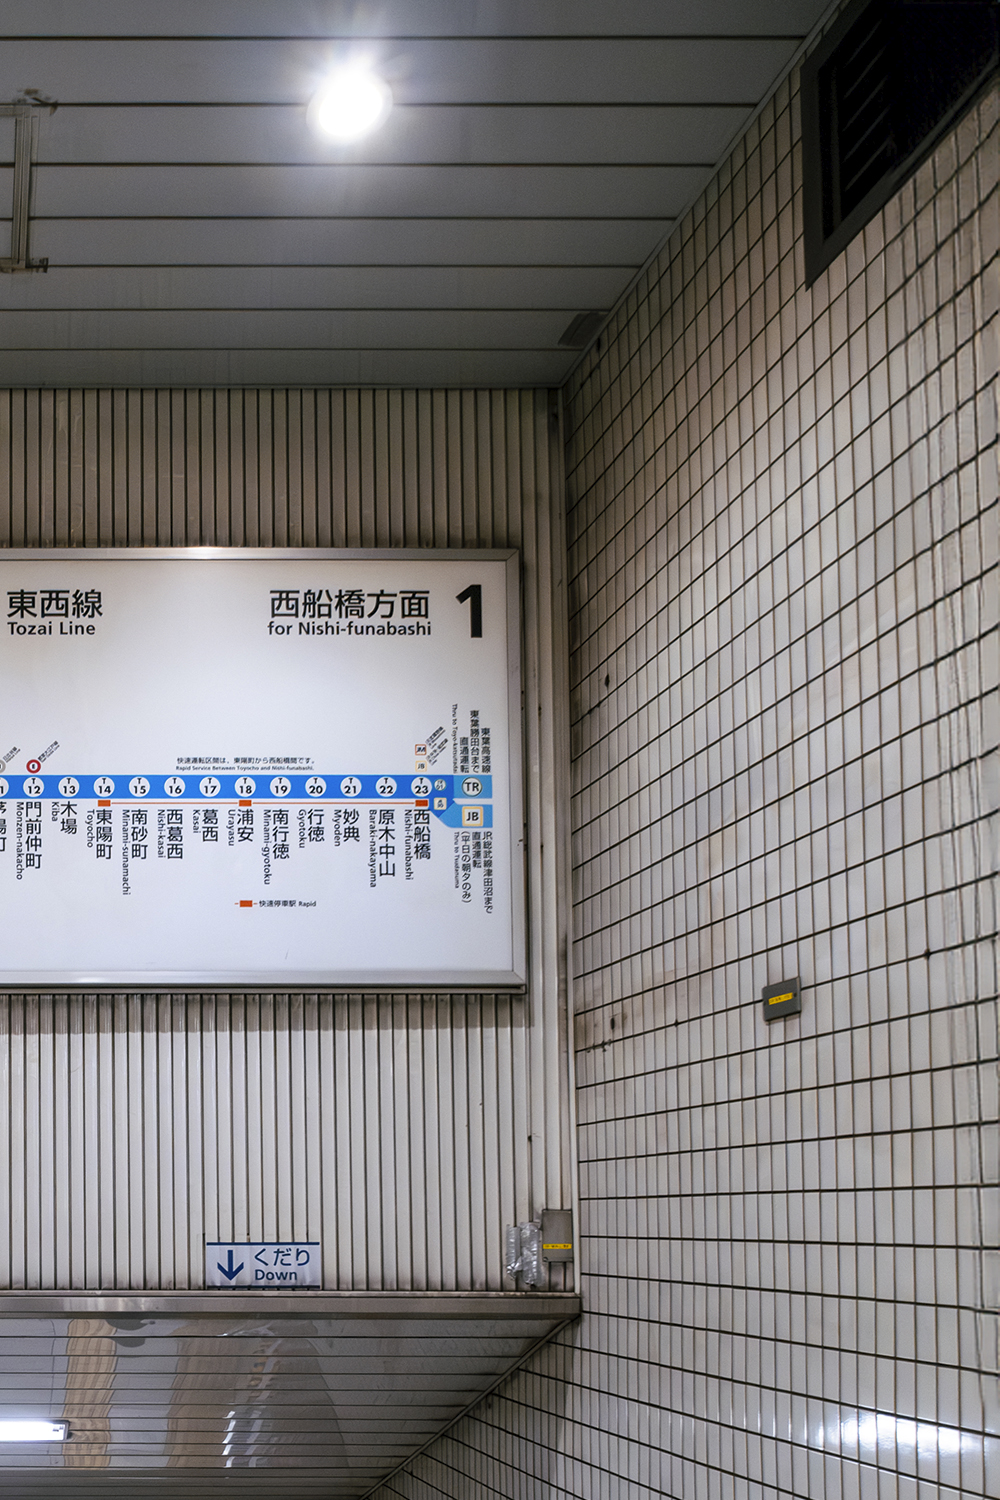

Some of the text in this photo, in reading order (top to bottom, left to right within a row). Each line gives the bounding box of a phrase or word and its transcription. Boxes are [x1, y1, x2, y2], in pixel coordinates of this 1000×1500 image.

[7, 589, 103, 619] 東西線
[269, 589, 430, 619] 西船橋方面
[455, 584, 483, 639] 1
[7, 621, 96, 636] Tozai Line
[267, 621, 432, 636] for Nishi-funabashi
[28, 785, 40, 794] 12
[63, 785, 76, 794] 13
[98, 785, 111, 794] 14
[133, 785, 146, 794] 15
[169, 785, 182, 794] 16
[204, 785, 217, 794] 17
[239, 785, 252, 794] 18
[275, 785, 288, 794] 19
[309, 785, 323, 794] 20
[344, 785, 357, 794] 21
[380, 785, 393, 794] 22
[414, 785, 428, 794] 23
[465, 782, 479, 792] TR
[52, 802, 60, 822] Kiba
[60, 801, 78, 835] 木場
[193, 809, 201, 834] Kasai
[466, 811, 479, 822] JB
[25, 801, 42, 869] 門前仲町
[85, 809, 95, 848] Toyocho
[96, 809, 113, 860] 東陽町
[131, 809, 148, 860] 南砂町
[157, 809, 166, 858] Nishi-kasai
[167, 809, 183, 859] 西葛西
[202, 809, 219, 842] 葛西
[226, 809, 235, 846] Urayasu
[237, 808, 254, 842] 浦安
[272, 809, 290, 860] 南行徳
[297, 810, 307, 849] Gyotoku
[307, 809, 325, 842] 行徳
[332, 809, 342, 847] Myoden
[343, 809, 360, 842] 妙典
[413, 809, 431, 860] 西船橋
[378, 809, 396, 877] 原木中山
[299, 900, 317, 908] Rapid
[254, 1247, 311, 1267] くだり
[254, 1269, 298, 1281] Down
